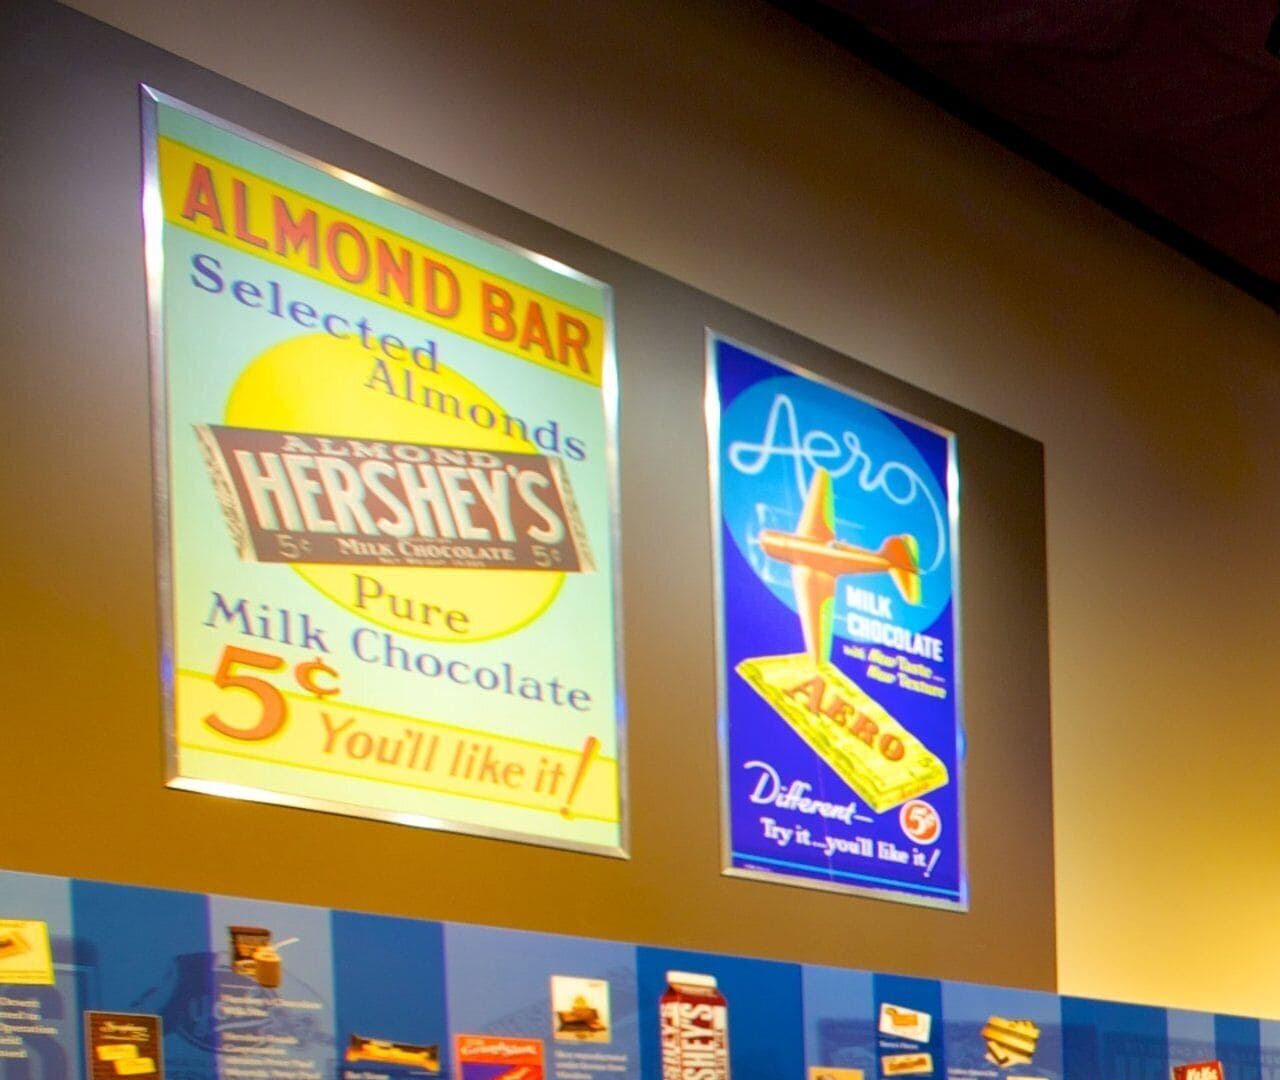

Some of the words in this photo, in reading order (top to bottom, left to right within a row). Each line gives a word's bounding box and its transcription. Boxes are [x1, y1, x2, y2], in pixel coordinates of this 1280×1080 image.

[182, 162, 461, 319] ALMOND
[482, 284, 591, 375] BAR
[190, 253, 440, 374] Selected
[282, 435, 503, 469] ALMOND
[364, 356, 587, 462] Almonds
[233, 449, 565, 543] HERSHEY'S
[729, 394, 945, 550] Aero
[354, 574, 471, 634] Pure
[846, 585, 892, 618] MILK
[847, 613, 944, 662] CHOCOLATE
[203, 645, 342, 743] 5¢
[204, 593, 330, 654] Milk
[351, 628, 592, 713] Chocolate
[783, 672, 907, 762] AERO
[320, 713, 440, 776] You'll
[448, 740, 524, 789] like
[534, 735, 599, 820] it!
[760, 817, 793, 846] Try
[878, 841, 909, 864] like
